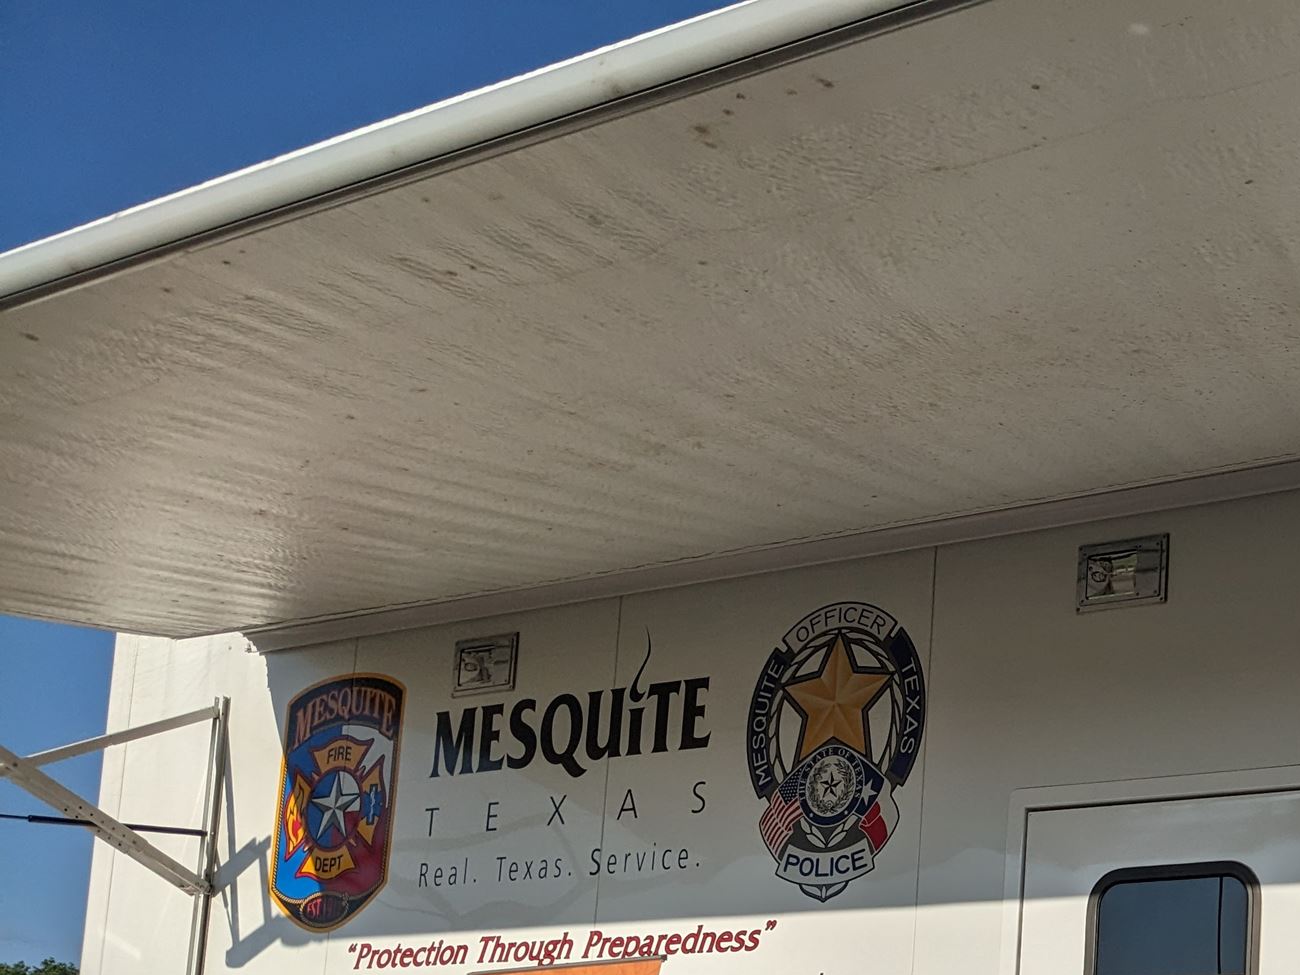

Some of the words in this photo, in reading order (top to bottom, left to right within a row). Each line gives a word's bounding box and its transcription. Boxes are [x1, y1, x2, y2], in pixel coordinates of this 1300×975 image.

[796, 607, 887, 642] OFFICER
[294, 686, 397, 748] MESQUITE
[753, 660, 784, 786] MESQUITE
[901, 657, 920, 755] TEXAS
[326, 746, 352, 764] FIRE
[806, 747, 834, 771] STATE
[838, 749, 850, 759] OF
[852, 757, 864, 799] TEXAS
[425, 781, 707, 837] TEXAS
[314, 854, 344, 873] DEPT
[418, 857, 477, 888] Real.
[496, 856, 572, 883] Texas.
[589, 842, 701, 876] Service.
[783, 848, 868, 877] POLICE
[477, 932, 573, 967] Through
